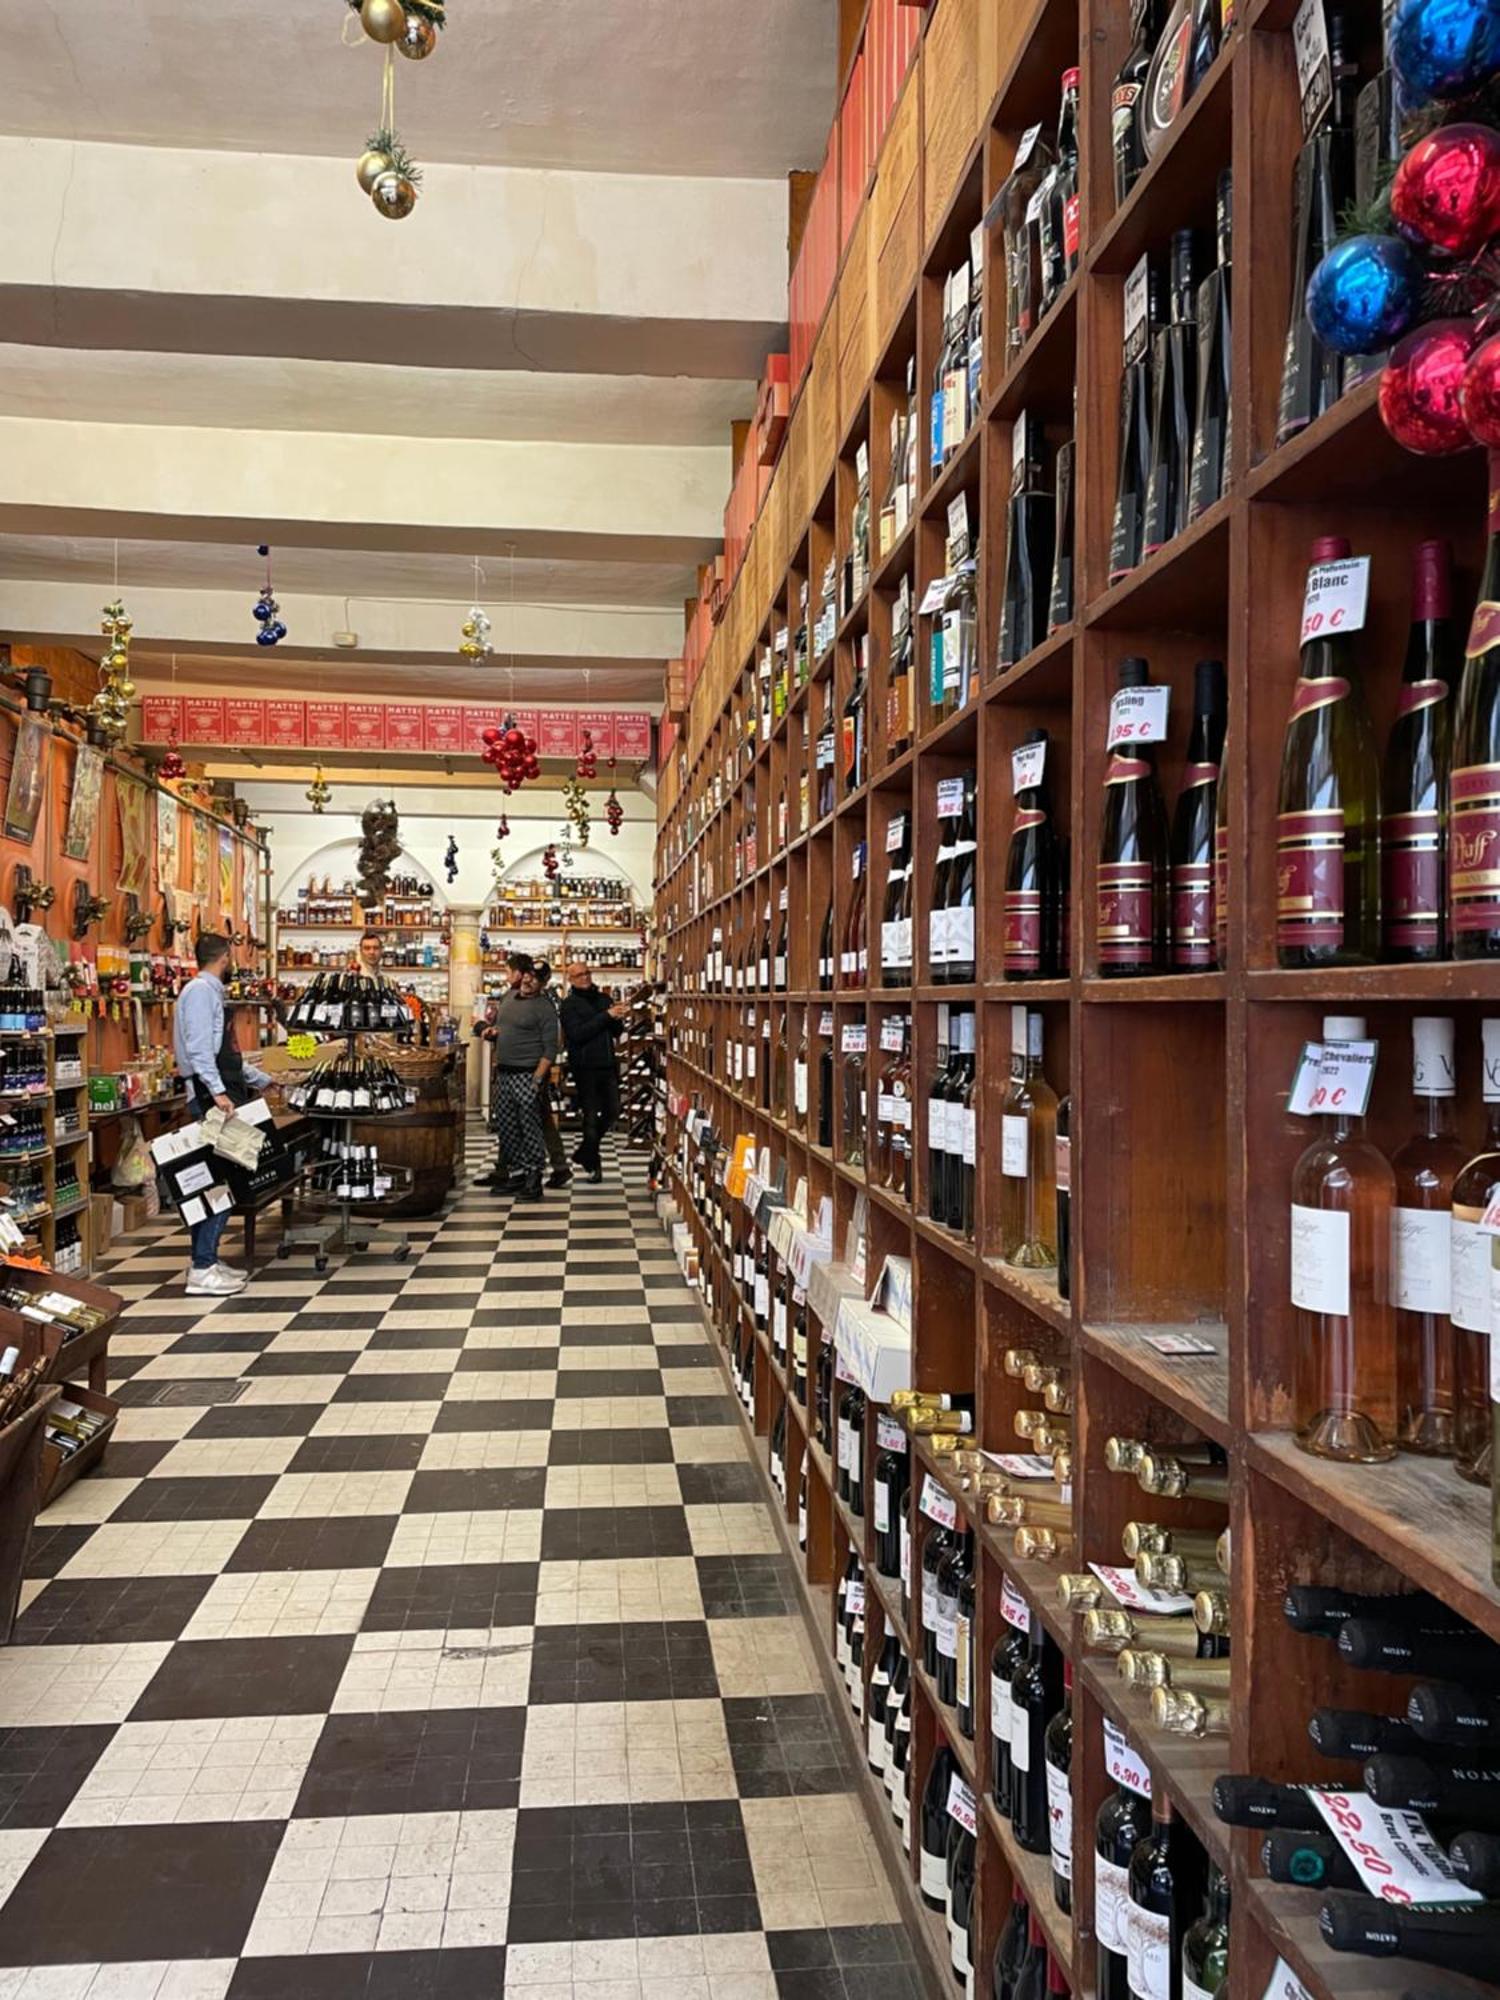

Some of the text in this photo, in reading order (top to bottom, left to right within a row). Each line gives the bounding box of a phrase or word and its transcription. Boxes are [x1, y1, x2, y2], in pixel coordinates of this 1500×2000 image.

[1311, 575, 1349, 591] Blanc
[1329, 608, 1346, 627] €
[1331, 1087, 1347, 1106] €
[1456, 1716, 1489, 1728] HATON
[1318, 1791, 1393, 1876] 22,50
[1379, 1812, 1399, 1841] Brut
[1366, 1931, 1398, 1943] HATON
